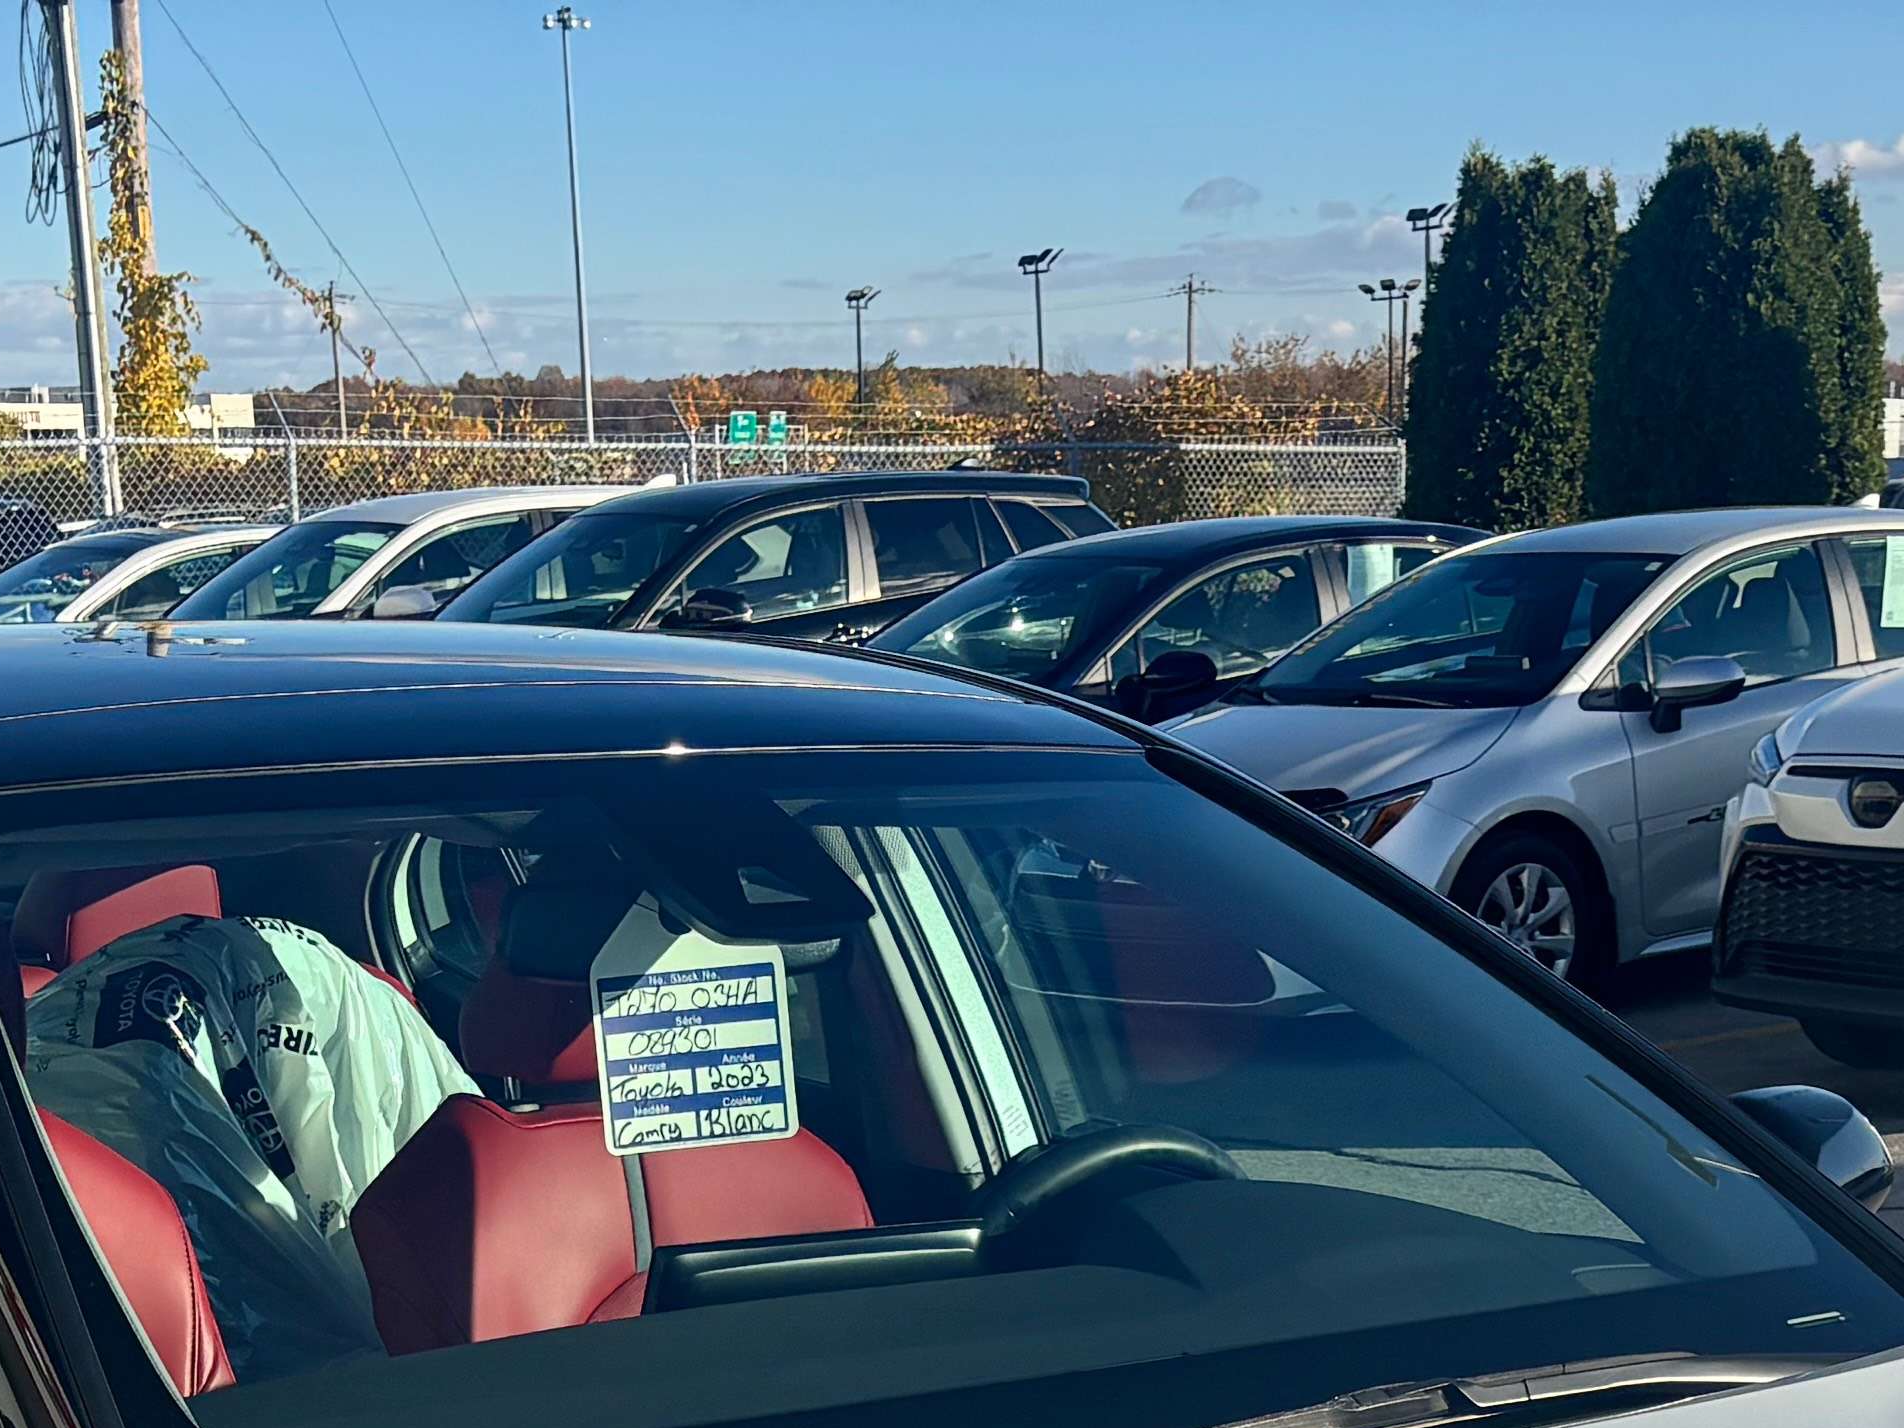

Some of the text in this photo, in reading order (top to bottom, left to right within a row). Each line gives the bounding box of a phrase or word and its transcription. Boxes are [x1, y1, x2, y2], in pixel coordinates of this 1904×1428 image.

[116, 971, 143, 1032] TOYOTA
[629, 1061, 666, 1073] Marque
[721, 1053, 756, 1063] Année
[610, 1073, 684, 1104] Toyota
[708, 1064, 770, 1090] 2023
[704, 1107, 775, 1136] Blanc
